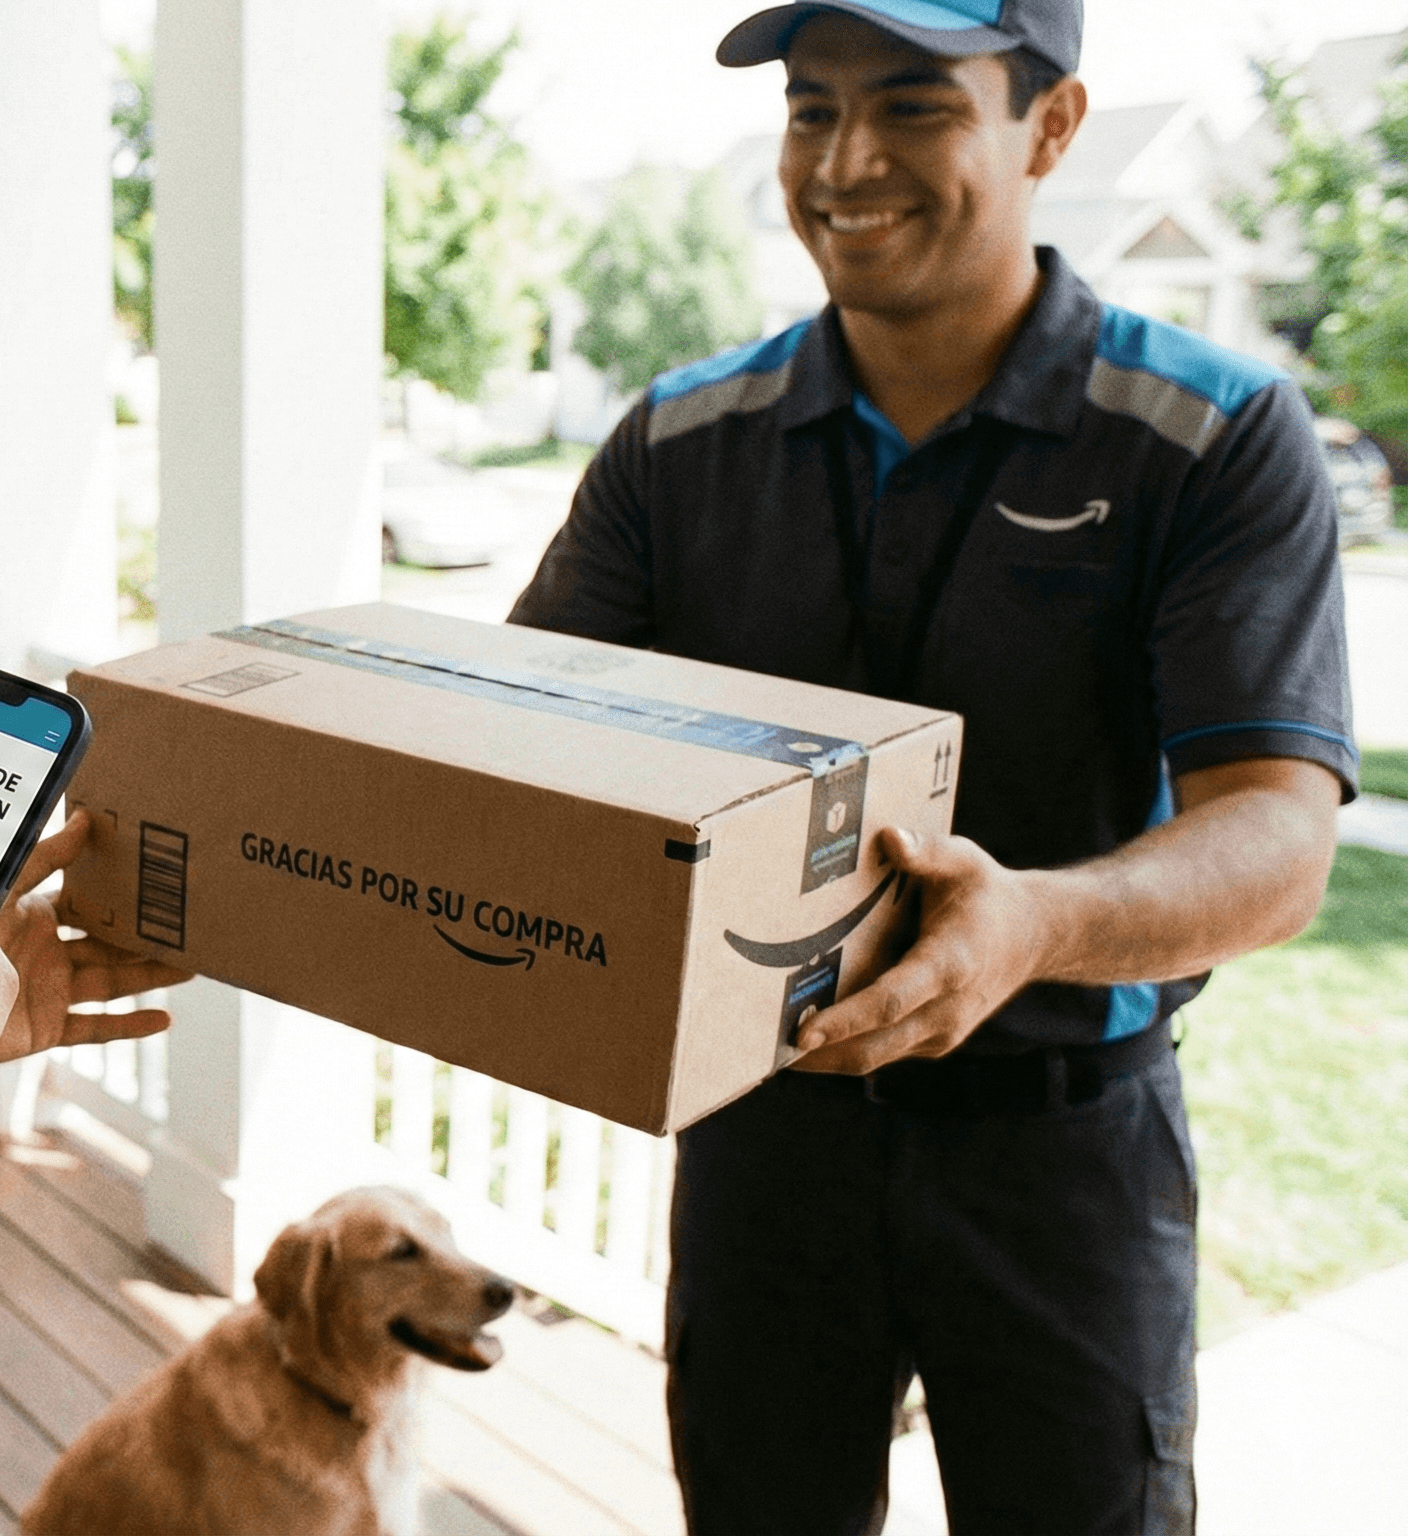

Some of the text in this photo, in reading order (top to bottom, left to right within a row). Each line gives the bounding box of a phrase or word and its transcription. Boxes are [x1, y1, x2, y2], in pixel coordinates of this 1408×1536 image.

[240, 832, 608, 968] GRACIAS POR SU COMPRA
